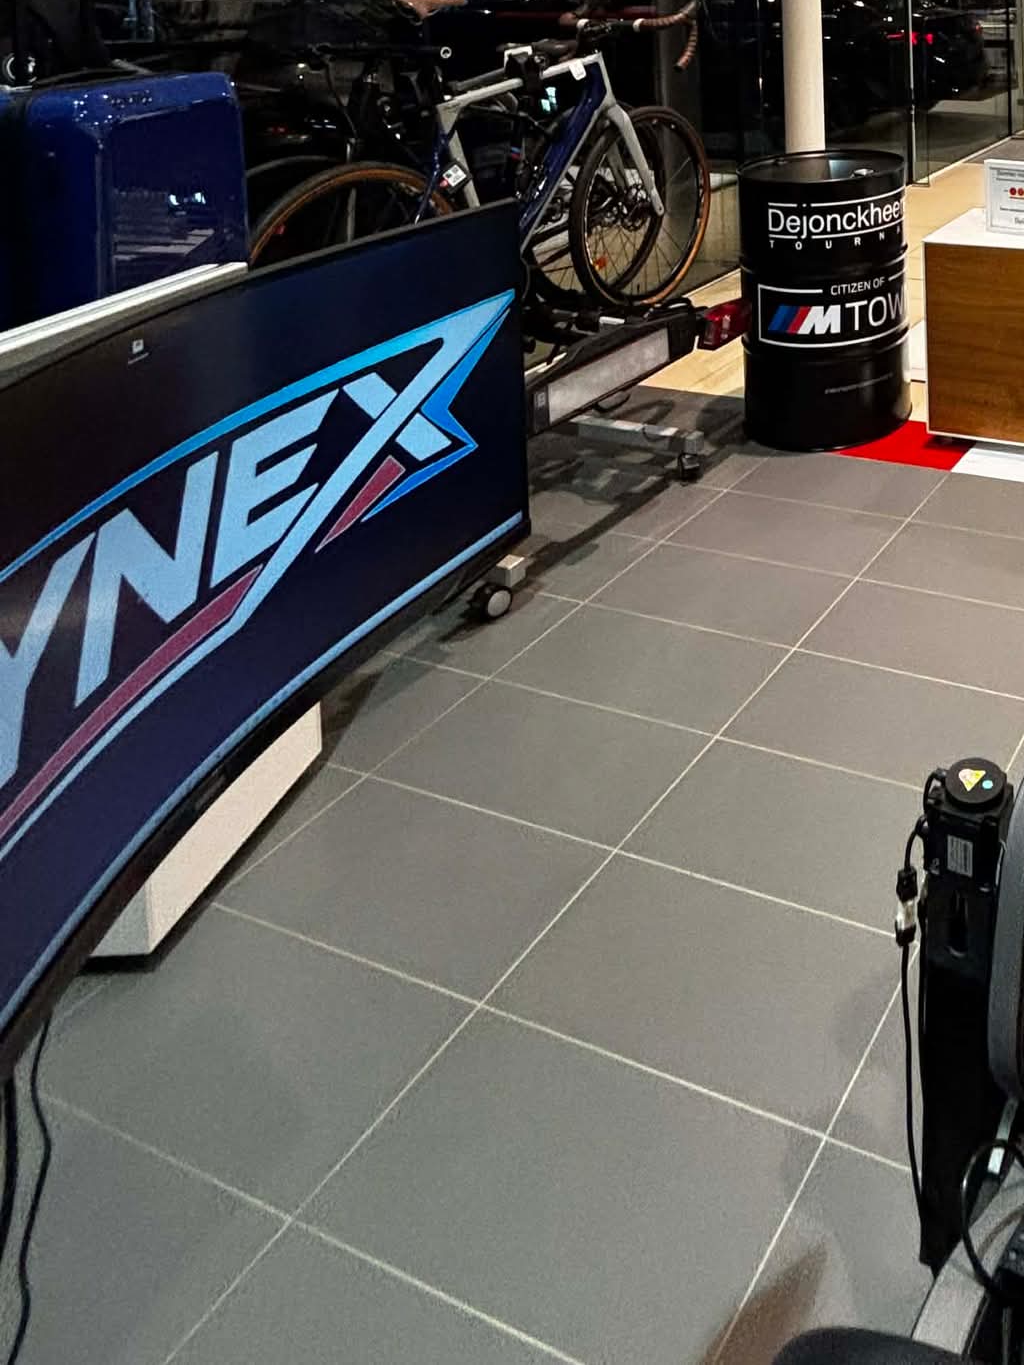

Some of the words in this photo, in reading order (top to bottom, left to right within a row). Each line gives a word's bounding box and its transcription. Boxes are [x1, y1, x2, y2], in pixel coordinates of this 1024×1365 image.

[767, 200, 905, 239] Dejonckhee
[830, 279, 871, 296] CITIZEN
[872, 276, 885, 289] OF
[797, 304, 842, 335] M
[845, 292, 906, 331] TOW
